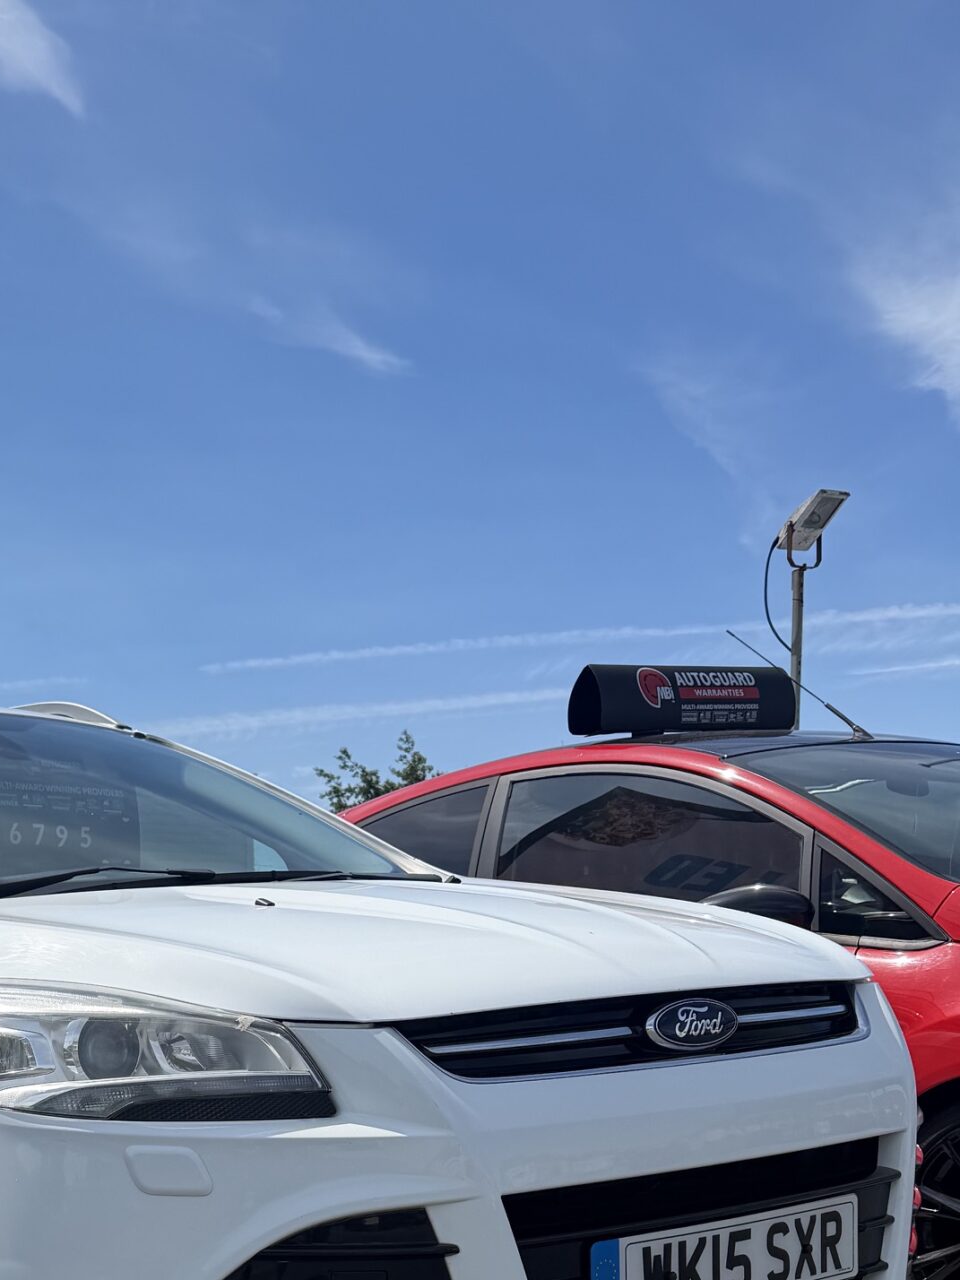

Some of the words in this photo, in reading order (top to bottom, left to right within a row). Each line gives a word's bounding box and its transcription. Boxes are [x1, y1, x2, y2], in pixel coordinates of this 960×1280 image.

[674, 672, 755, 686] AUTOGUARD
[694, 688, 745, 697] WARRANTIES
[675, 1006, 724, 1038] Ford
